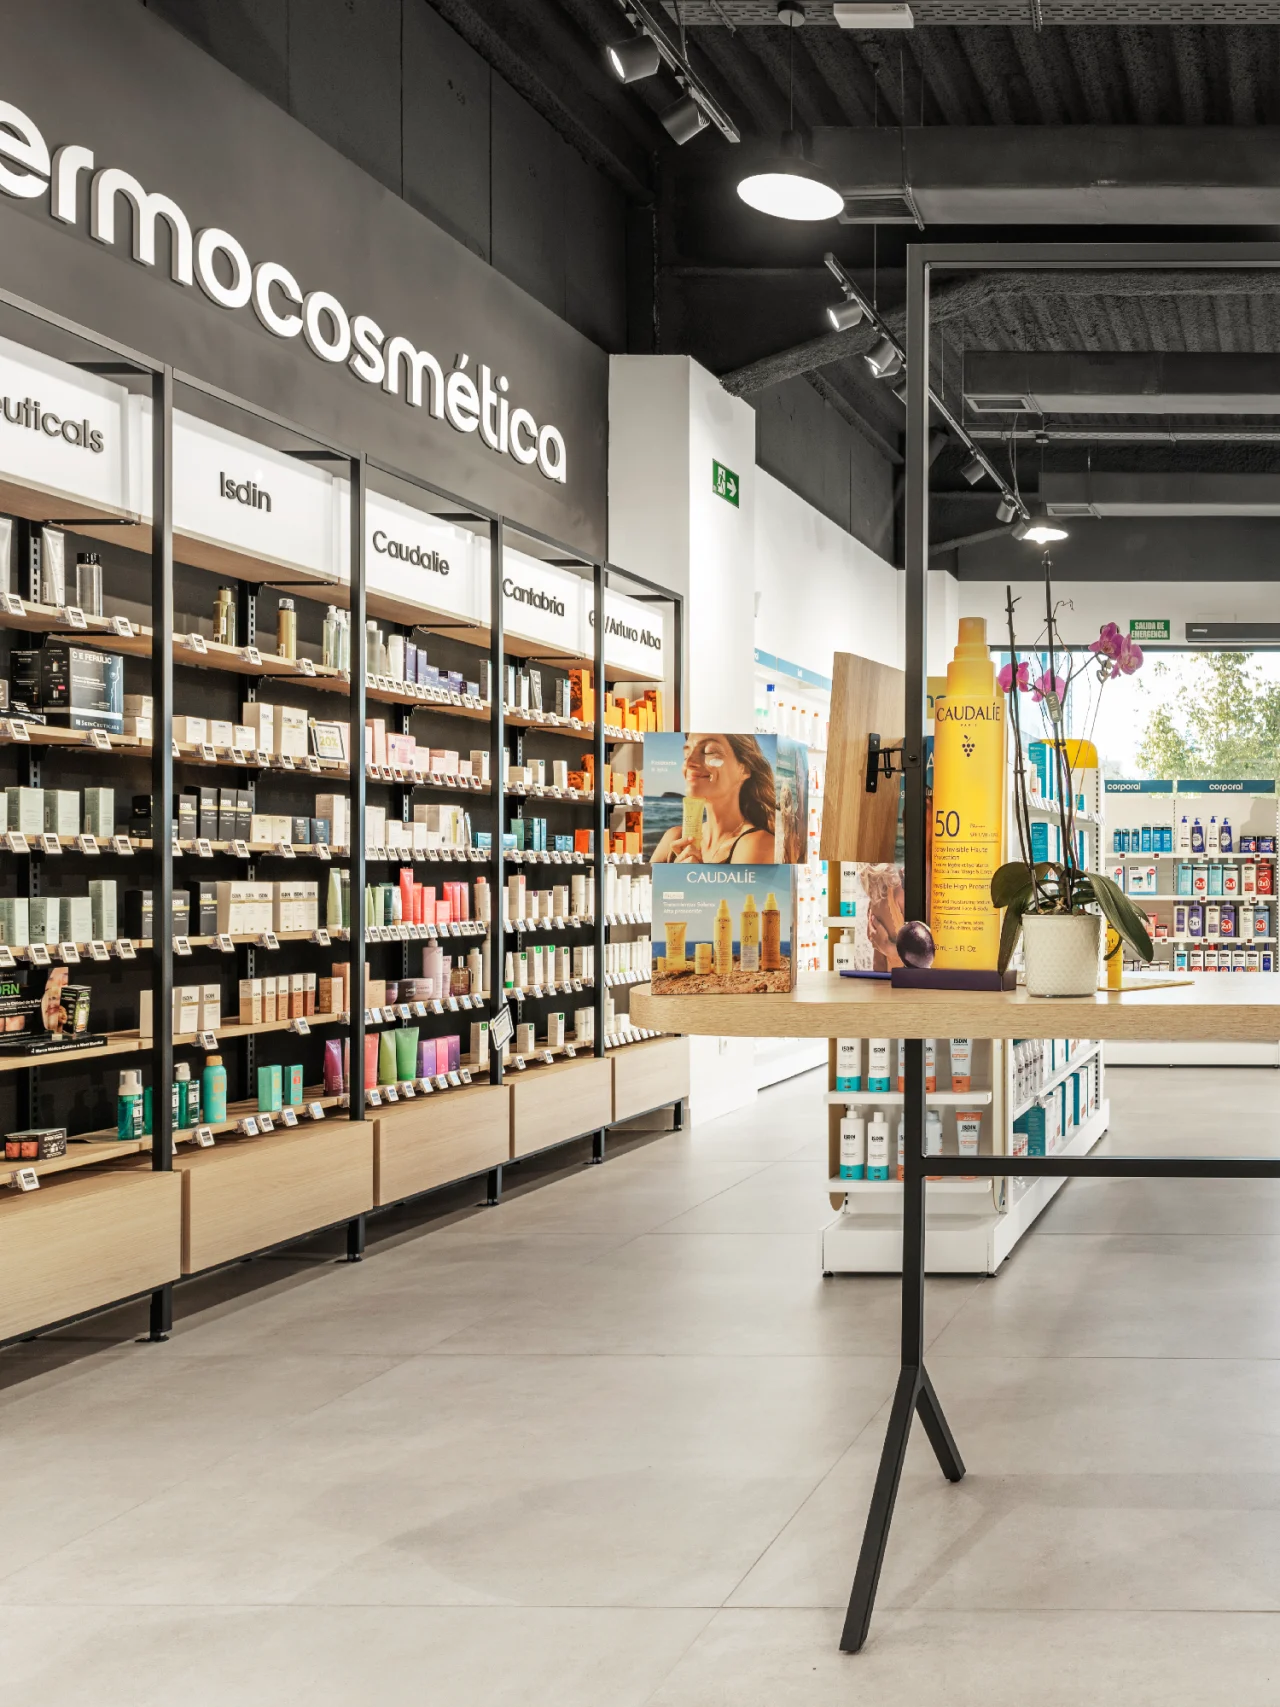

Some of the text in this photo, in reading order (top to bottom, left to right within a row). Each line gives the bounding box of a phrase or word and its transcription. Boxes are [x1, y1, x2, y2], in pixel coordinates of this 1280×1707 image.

[0, 397, 104, 453] uticals
[220, 471, 272, 512] Isdin
[373, 530, 450, 576] Caudalie
[502, 578, 565, 617] Cantabria
[1131, 630, 1169, 638] EMERGENCIA
[1134, 621, 1165, 630] SALIDA DE
[639, 629, 661, 650] Alba
[84, 653, 112, 665] FERULIC
[936, 702, 1001, 722] CAUDALÍE
[1107, 782, 1141, 792] corporal
[1209, 782, 1244, 792] corporal
[935, 810, 960, 837] 50
[686, 869, 756, 884] CAUDALÍE
